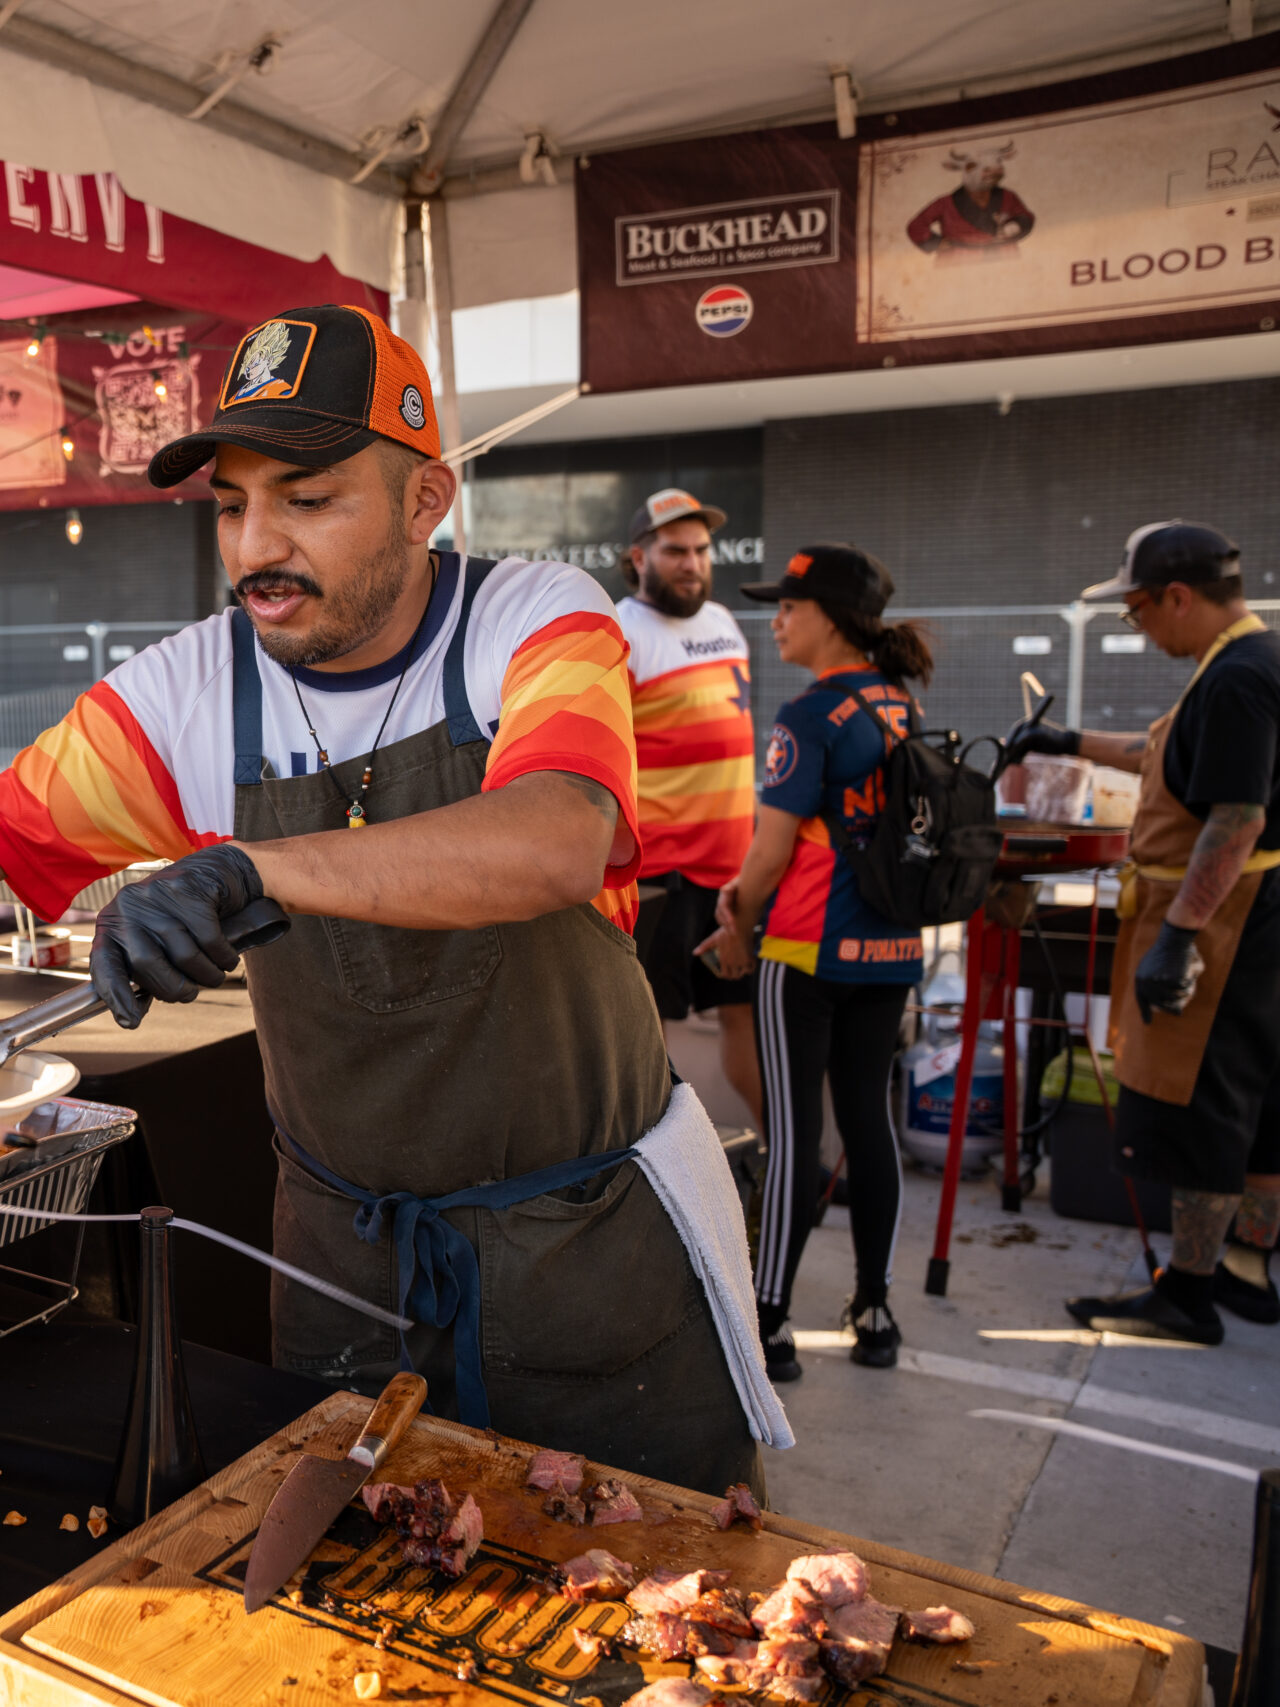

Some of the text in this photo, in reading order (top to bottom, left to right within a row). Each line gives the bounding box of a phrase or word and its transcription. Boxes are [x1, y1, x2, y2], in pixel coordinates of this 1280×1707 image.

[625, 207, 827, 260] BUCKHEAD
[1070, 236, 1280, 287] BLOOD B
[699, 303, 749, 318] PEPSI
[108, 325, 186, 359] VOTE
